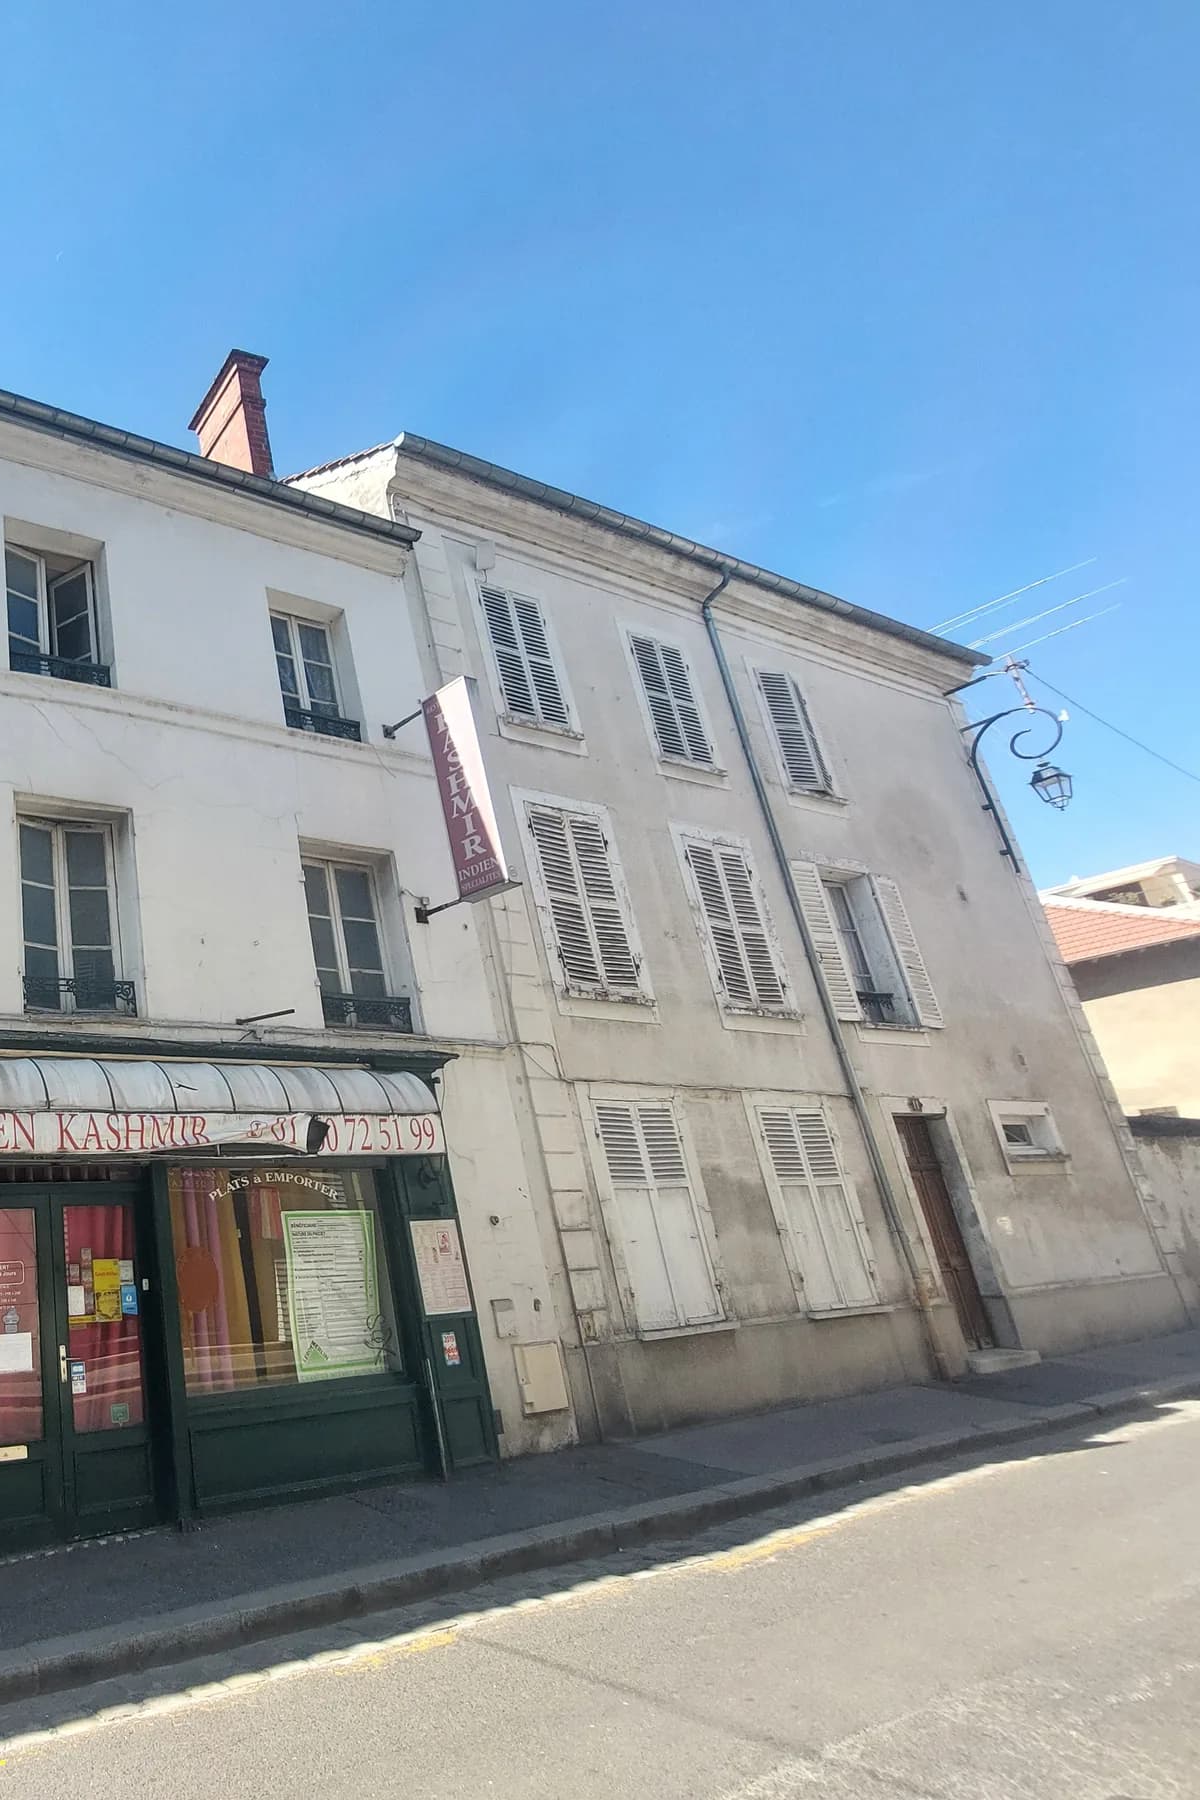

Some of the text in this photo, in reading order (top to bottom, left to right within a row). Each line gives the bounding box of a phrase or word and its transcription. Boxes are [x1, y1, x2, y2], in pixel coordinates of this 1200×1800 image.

[458, 857, 498, 881] INDIEN
[56, 1113, 211, 1151] KASHMIR
[319, 1117, 339, 1152] 0
[343, 1117, 373, 1151] 72
[378, 1117, 405, 1151] 51
[409, 1117, 435, 1151] 99
[208, 1175, 250, 1201] PLATS
[265, 1172, 339, 1201] EMPORTER
